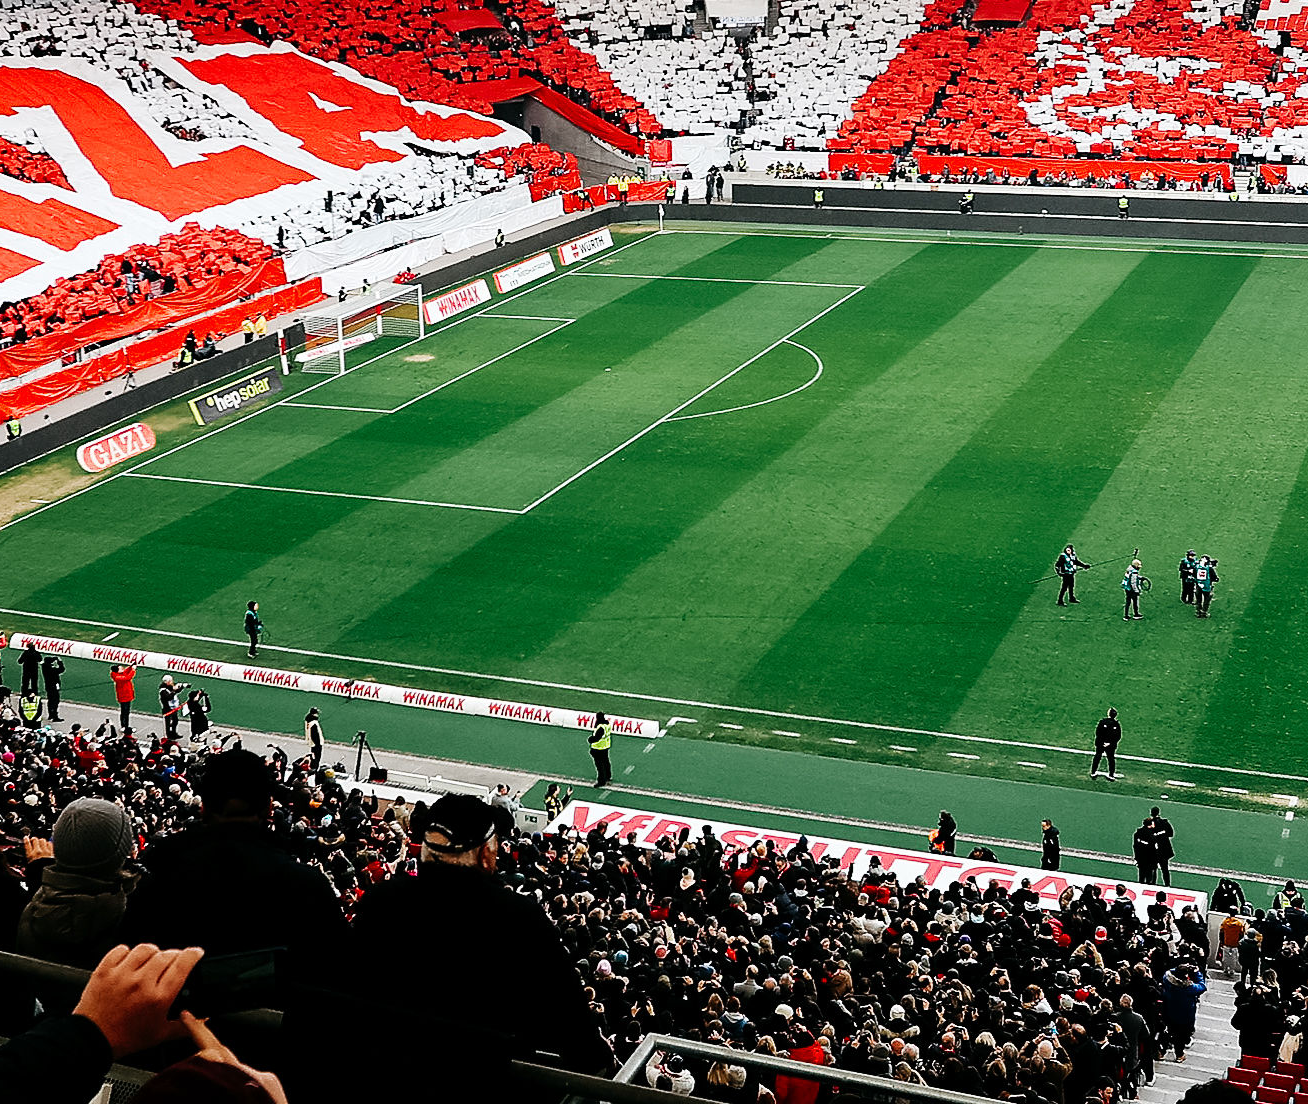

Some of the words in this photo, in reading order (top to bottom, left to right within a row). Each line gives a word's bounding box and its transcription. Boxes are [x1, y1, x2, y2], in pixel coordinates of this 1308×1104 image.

[437, 285, 481, 318] WINAMAX
[93, 646, 147, 666] WINAMAX
[166, 657, 223, 677] WINAMAX
[243, 669, 301, 688] WINAMAX
[402, 691, 466, 711] WINAMAX
[488, 702, 553, 723] WINAMAX
[577, 714, 644, 735] WIMAX
